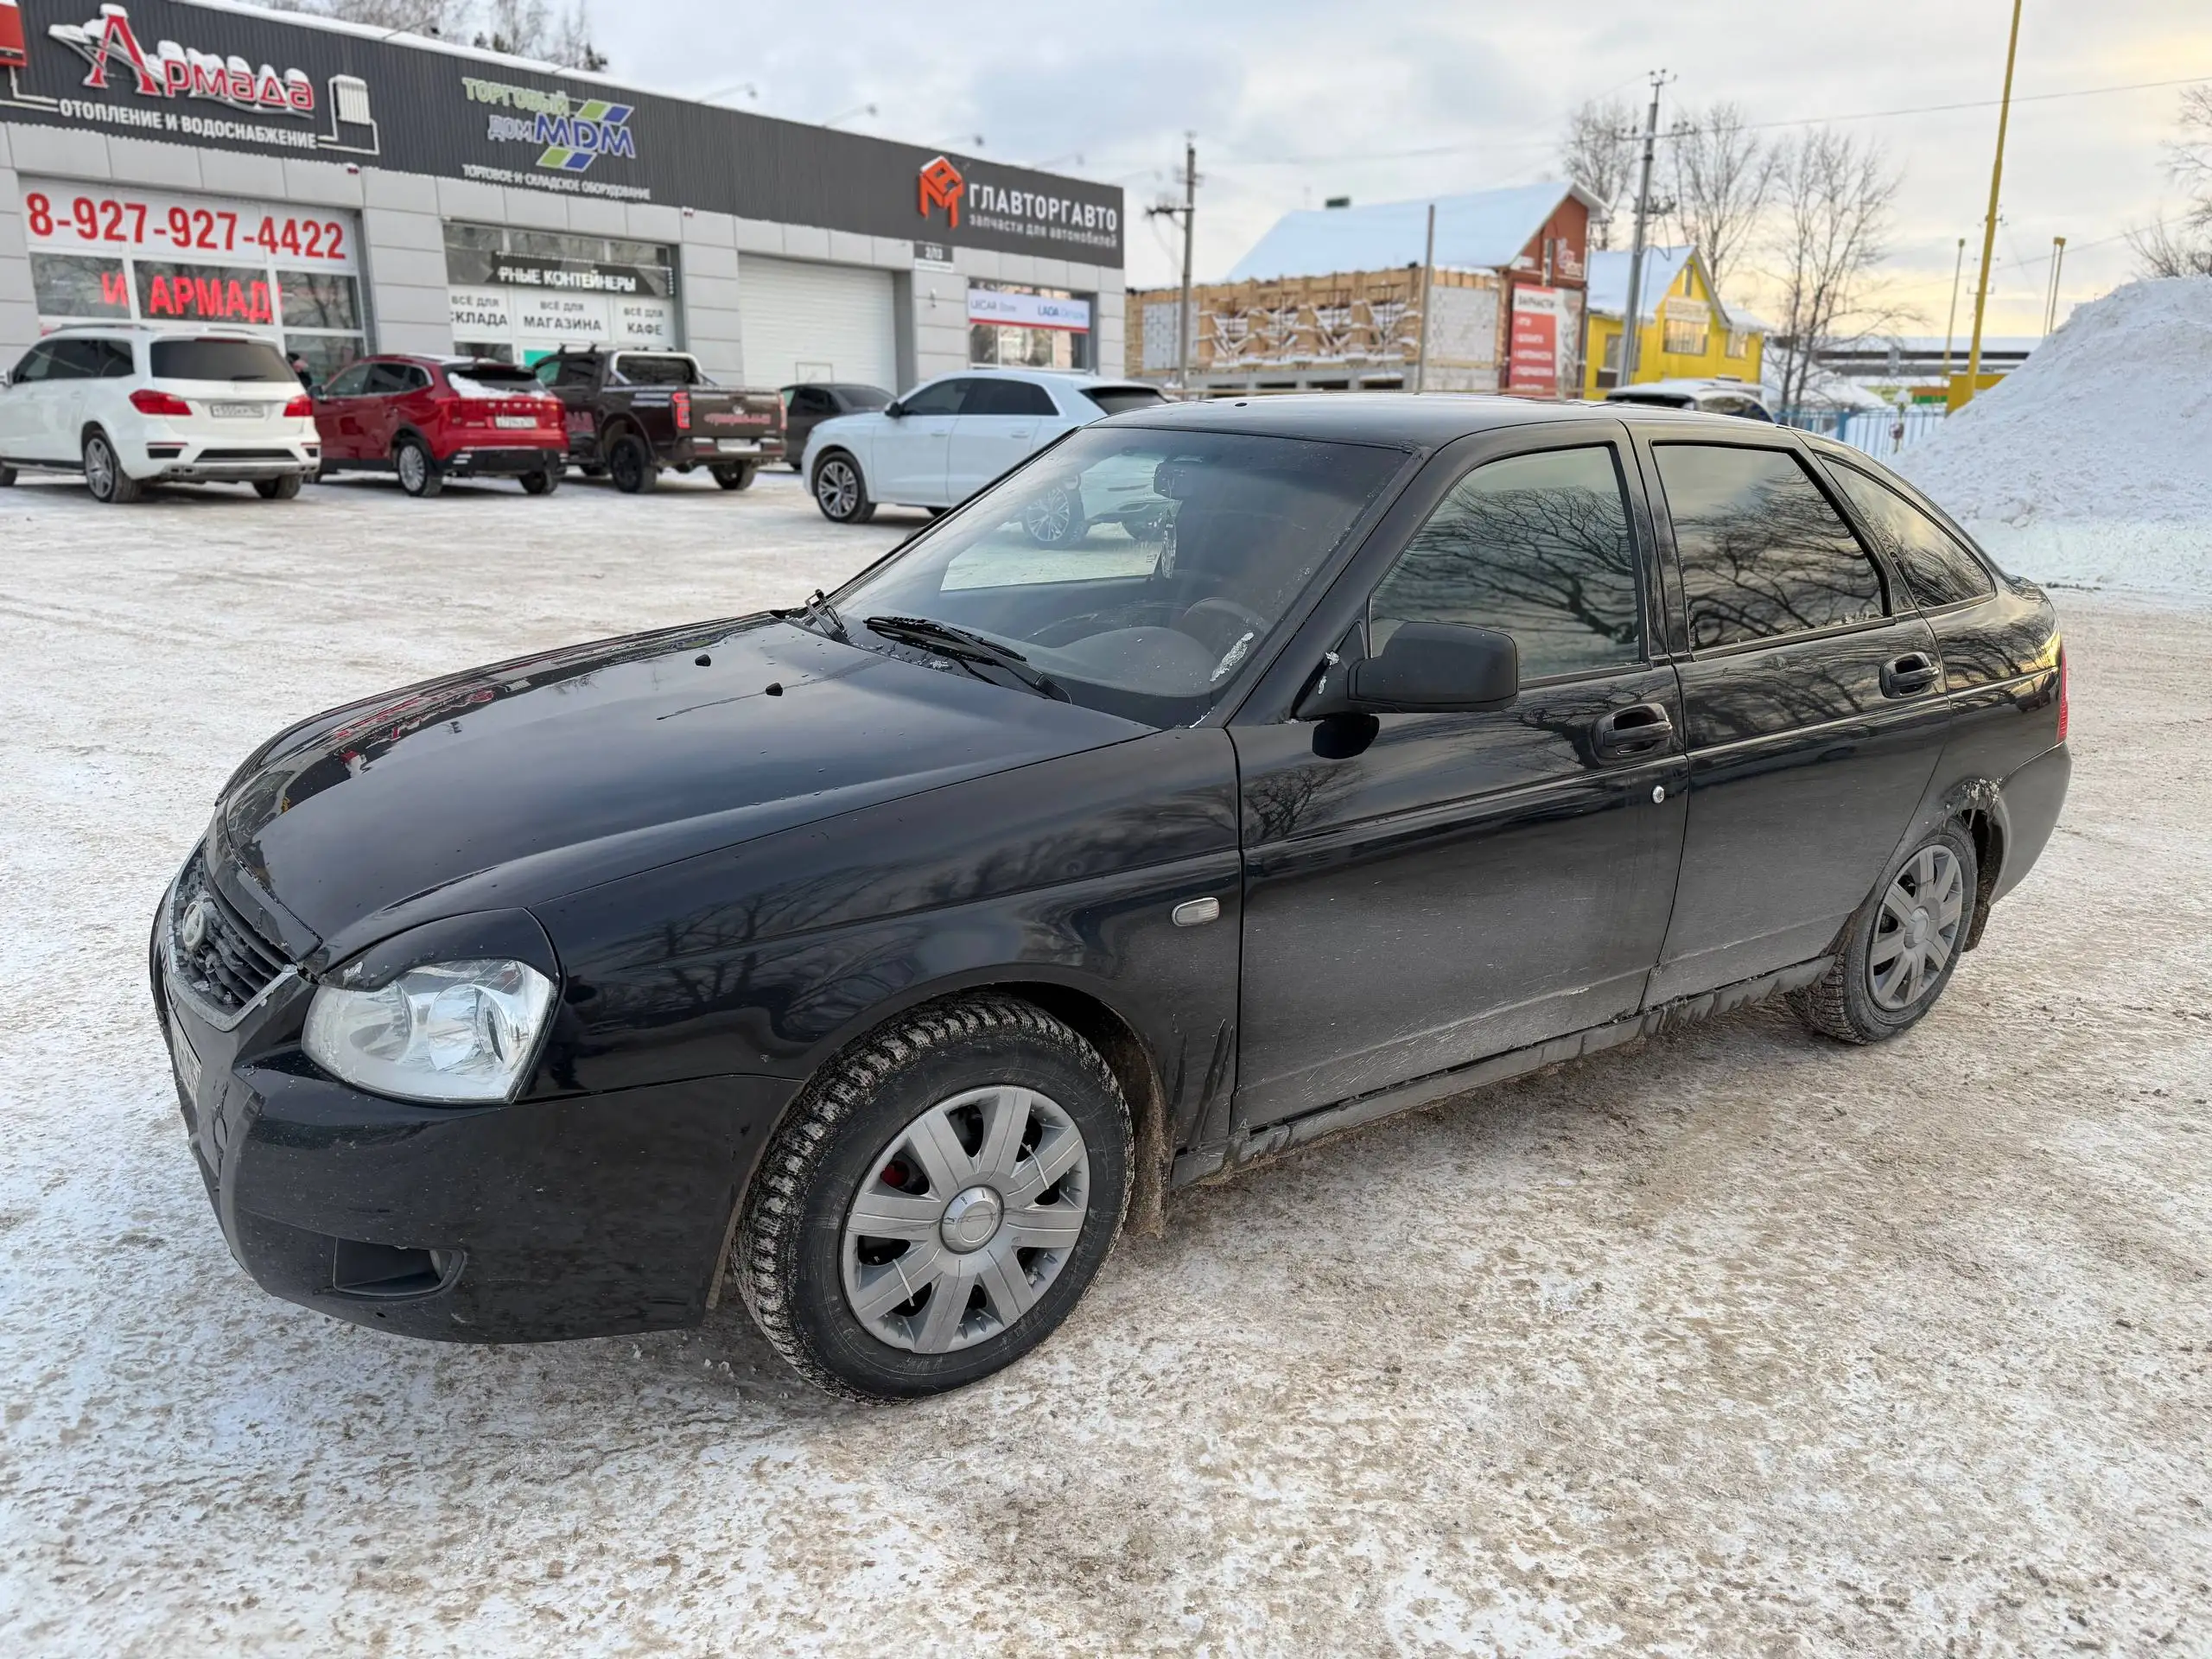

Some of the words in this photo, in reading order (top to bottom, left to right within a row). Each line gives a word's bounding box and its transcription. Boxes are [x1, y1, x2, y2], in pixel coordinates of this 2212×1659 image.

[59, 98, 162, 129] ОТОПЛЕНИЕ
[165, 114, 178, 130] И
[181, 117, 317, 149] ВОДОСНАБЖЕНИЕ
[462, 164, 512, 182] ТОРГОВОЕ
[524, 172, 580, 192] СКЛАДСКОЕ
[582, 180, 651, 200] ОБОРУДОВАНИЕ
[969, 182, 1117, 232] ГЛАВТОРГАВТО
[25, 192, 346, 259] 8-927-927-4422
[969, 213, 1024, 235] запчасти
[1026, 223, 1047, 238] для
[1048, 226, 1117, 249] автомобилей
[543, 270, 637, 292] КОНТЕЙНЕРЫ
[149, 275, 283, 324] АРМАД
[450, 310, 508, 327] КЛАДА
[524, 316, 601, 332] МАГАЗИНА
[626, 322, 663, 336] КАФЕ
